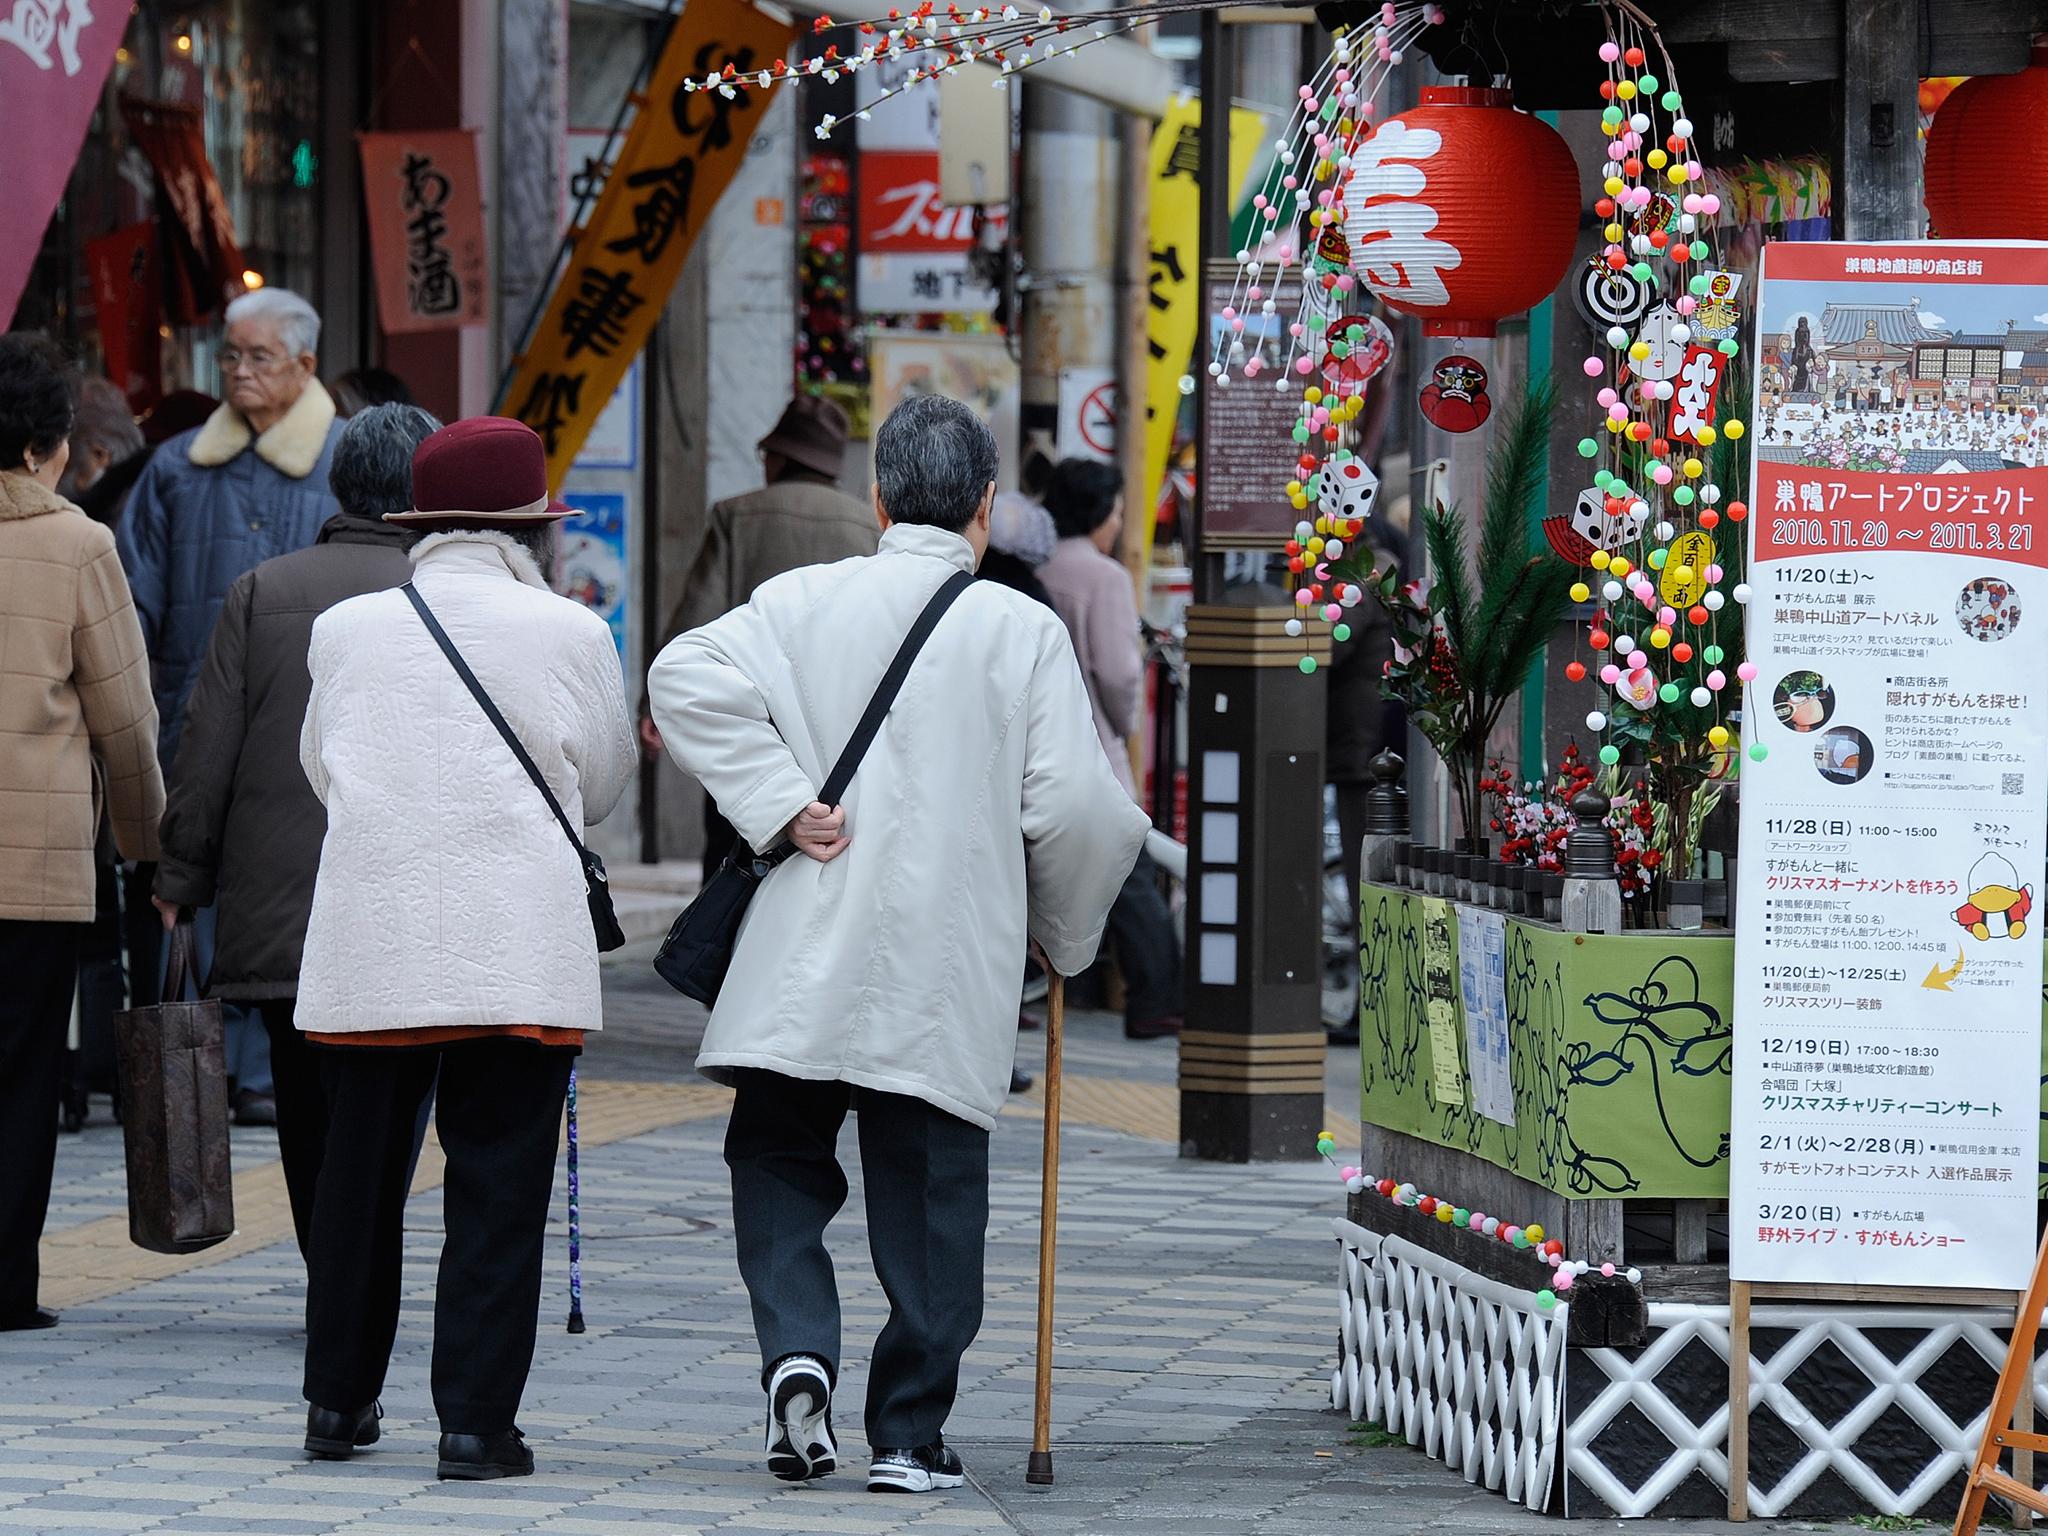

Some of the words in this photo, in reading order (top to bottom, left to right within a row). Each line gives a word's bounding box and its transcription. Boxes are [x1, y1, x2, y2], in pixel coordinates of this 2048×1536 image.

[400, 153, 460, 317] あま酒
[1845, 257, 1983, 275] 巣鴨地蔵通り商店街
[1711, 275, 1731, 297] 宝
[1774, 479, 2034, 515] 巣鴨アートプロジェクト
[1772, 519, 1888, 546] 2010.11.20
[1930, 522, 2032, 550] 2011.3.21
[1671, 533, 1706, 606] 金百両
[1775, 568, 1875, 585] 11/20（土）～
[1784, 592, 1847, 605] すがもん広場
[1853, 594, 1876, 606] 展示
[1774, 608, 1939, 627] 巣鴨中山道アートパネル
[1773, 633, 1863, 645] 江戸と現代がミックス？
[1868, 635, 1953, 647] 見ているだけで楽しい
[1773, 646, 1929, 658] 巣鴨中山道イラストマップが広場に登場！
[1894, 676, 1949, 688] 商店街各所
[1886, 692, 2028, 709] 隠れすがもんを探せ！
[1885, 714, 2012, 726] 街のあちこちに隠れたすがもんを
[1885, 726, 1959, 736] 見つけられるかな？
[1885, 738, 2003, 750] ヒントは商店街ホームページの
[1766, 819, 1852, 837] 11/28（日）
[1770, 841, 1847, 853] アートワークショップ
[1766, 858, 1859, 873] すがもんと一緒に
[1766, 876, 1958, 895] クリスマスオーナメントを作ろう
[1774, 899, 1851, 911] 巣鴨郵便局前にて
[1774, 925, 1920, 938] 参加の方にすがもん飴プレゼント！
[1773, 982, 1831, 993] 巣鴨郵便局前
[1763, 995, 1882, 1011] クリスマスツリー装飾
[1761, 1038, 1850, 1056] 12/19（日）
[1761, 1079, 1843, 1093] 合唱団「大塚」
[1762, 1094, 2003, 1117] クリスマスチャリティーコンサート
[1760, 1135, 1924, 1155] 2/1（火）～2/28（月）
[1938, 1144, 1998, 1156] 巣鴨信用金庫
[2000, 1146, 2021, 1157] 本店
[1759, 1161, 1921, 1179] すがモットフォトコンテスト
[1926, 1166, 2013, 1182] 入選作品展示
[1759, 1204, 1841, 1222] 3/20（日）
[1861, 1210, 1925, 1222] すがもん広場
[1758, 1226, 1965, 1248] 野外ライブ・すがもんショー
